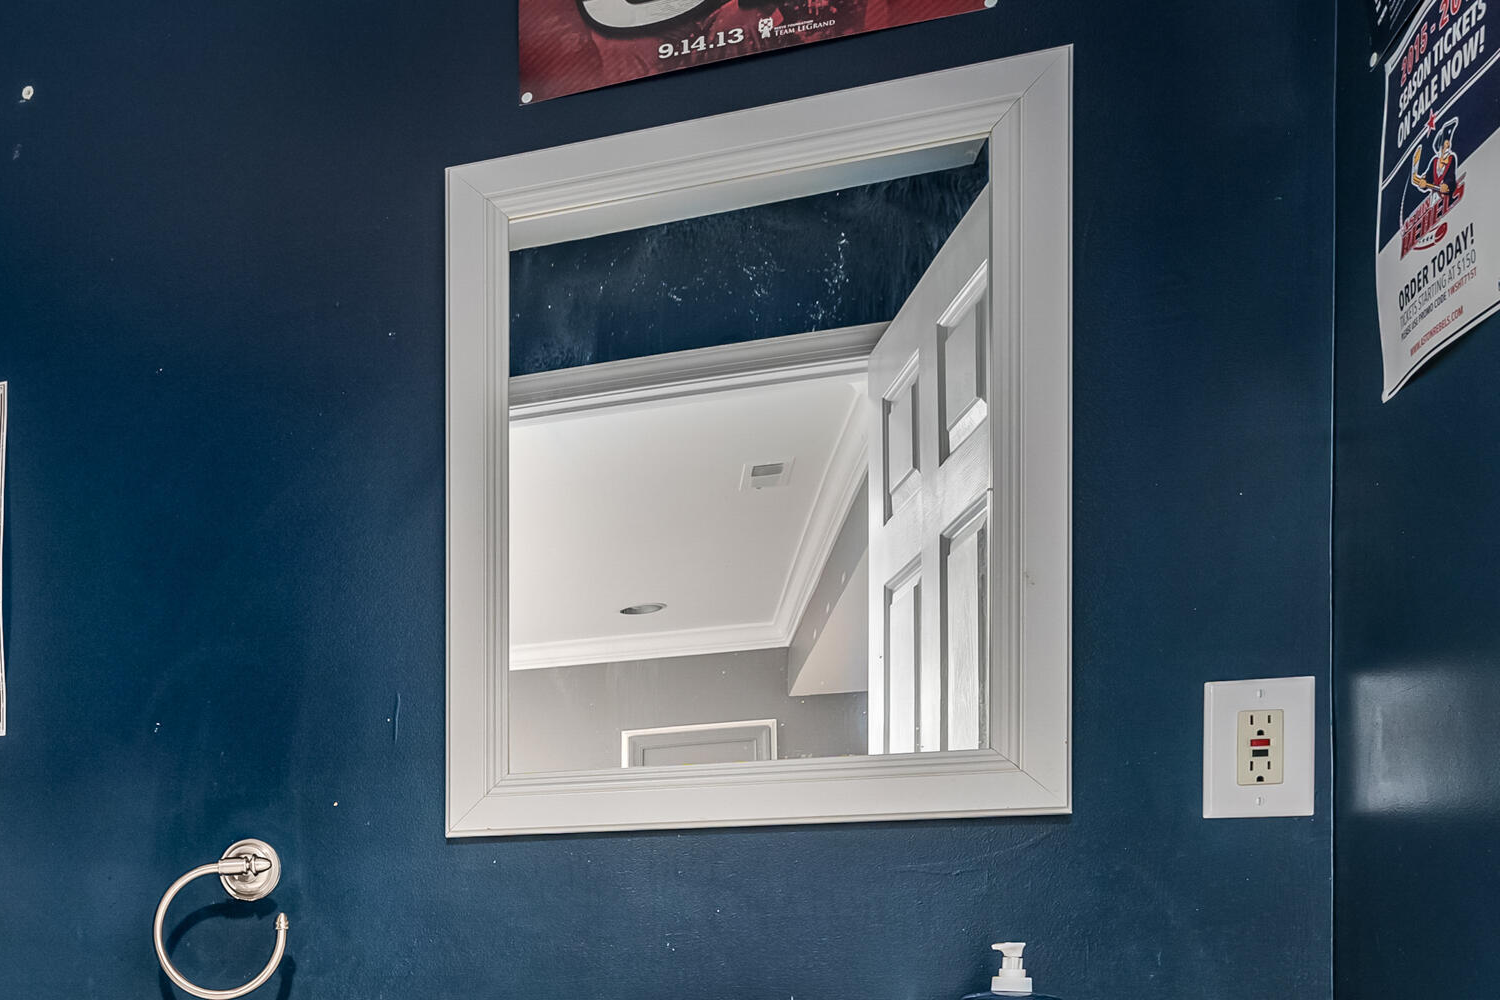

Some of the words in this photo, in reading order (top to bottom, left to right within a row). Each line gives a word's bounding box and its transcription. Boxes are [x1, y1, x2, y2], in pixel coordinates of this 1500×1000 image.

[658, 28, 745, 59] 9.14.13
[775, 27, 796, 37] TEAM
[1398, 51, 1431, 118] SEASON
[1432, 0, 1486, 67] TICKETS
[1397, 111, 1411, 148] ON
[1412, 74, 1439, 128] SALE
[1441, 24, 1486, 92] NOW!
[1398, 265, 1429, 311] ORDER
[1431, 222, 1474, 278] TODAY!
[1447, 265, 1456, 283] AT
[1457, 248, 1477, 276] $150
